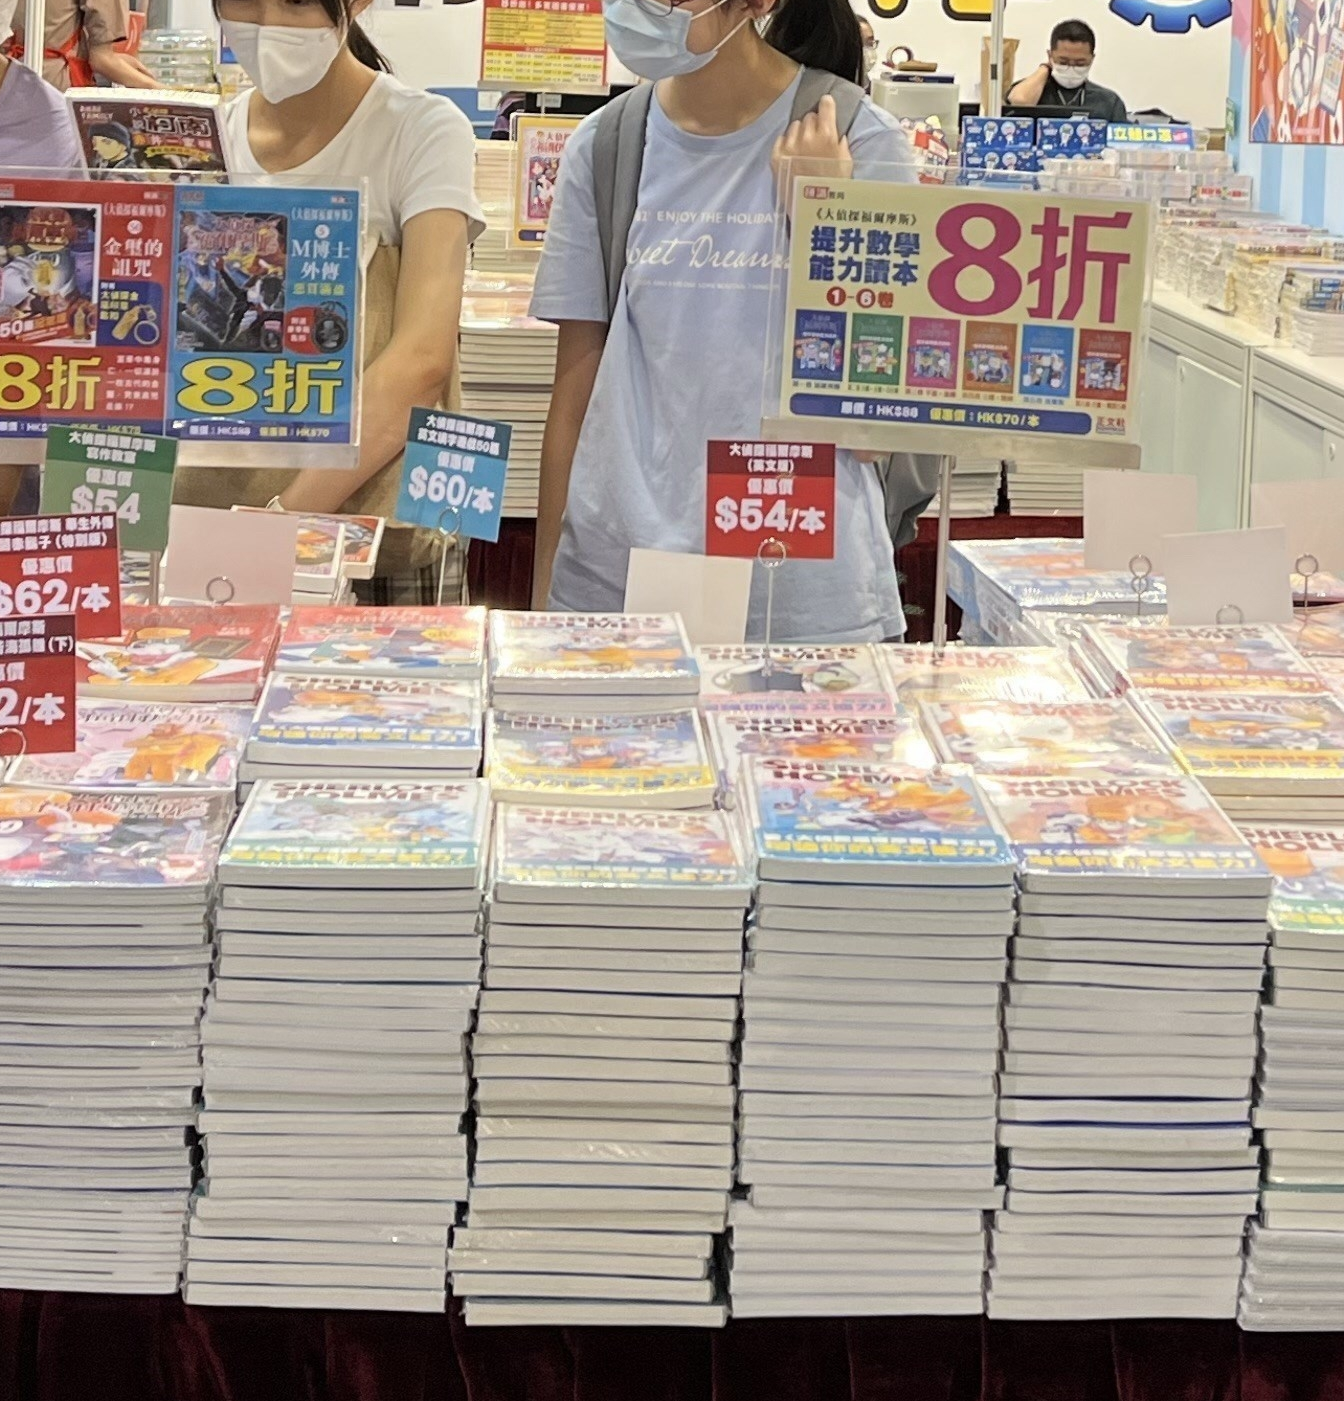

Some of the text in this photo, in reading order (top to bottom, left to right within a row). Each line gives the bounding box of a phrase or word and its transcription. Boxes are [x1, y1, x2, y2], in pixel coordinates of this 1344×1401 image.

[700, 212, 723, 224] THE
[815, 207, 918, 227] 《大偵探福爾摩斯》
[291, 239, 350, 260] M博士
[810, 225, 921, 258] 提升數學
[300, 261, 341, 281] 外傳
[808, 255, 919, 286] 能力讀本
[926, 202, 1134, 324] 8折
[176, 357, 343, 416] 8折
[436, 451, 476, 473] 優惠價
[85, 467, 133, 488] 優惠價
[746, 477, 794, 496] 優惠價
[408, 465, 495, 514] $60/本
[70, 484, 141, 525] $54
[714, 497, 826, 535] $54/本
[21, 555, 73, 575] 優惠價
